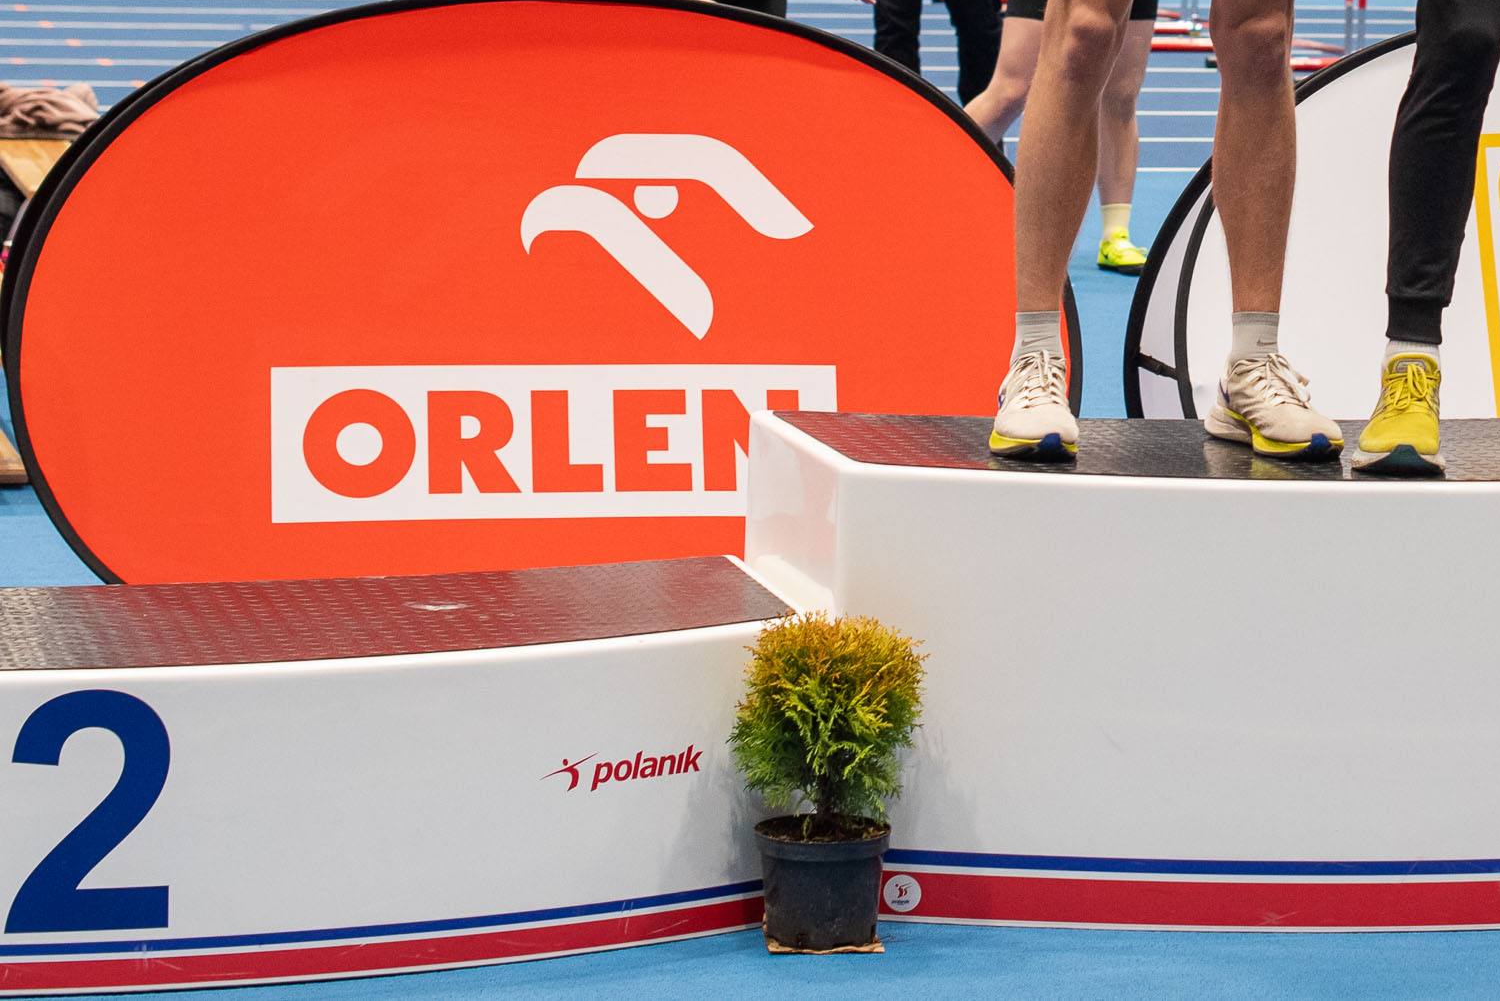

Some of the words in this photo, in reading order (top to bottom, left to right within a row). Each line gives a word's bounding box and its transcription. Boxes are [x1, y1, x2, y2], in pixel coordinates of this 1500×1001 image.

[303, 388, 800, 498] ORLEN
[4, 689, 170, 934] 2
[590, 744, 702, 792] polanik
